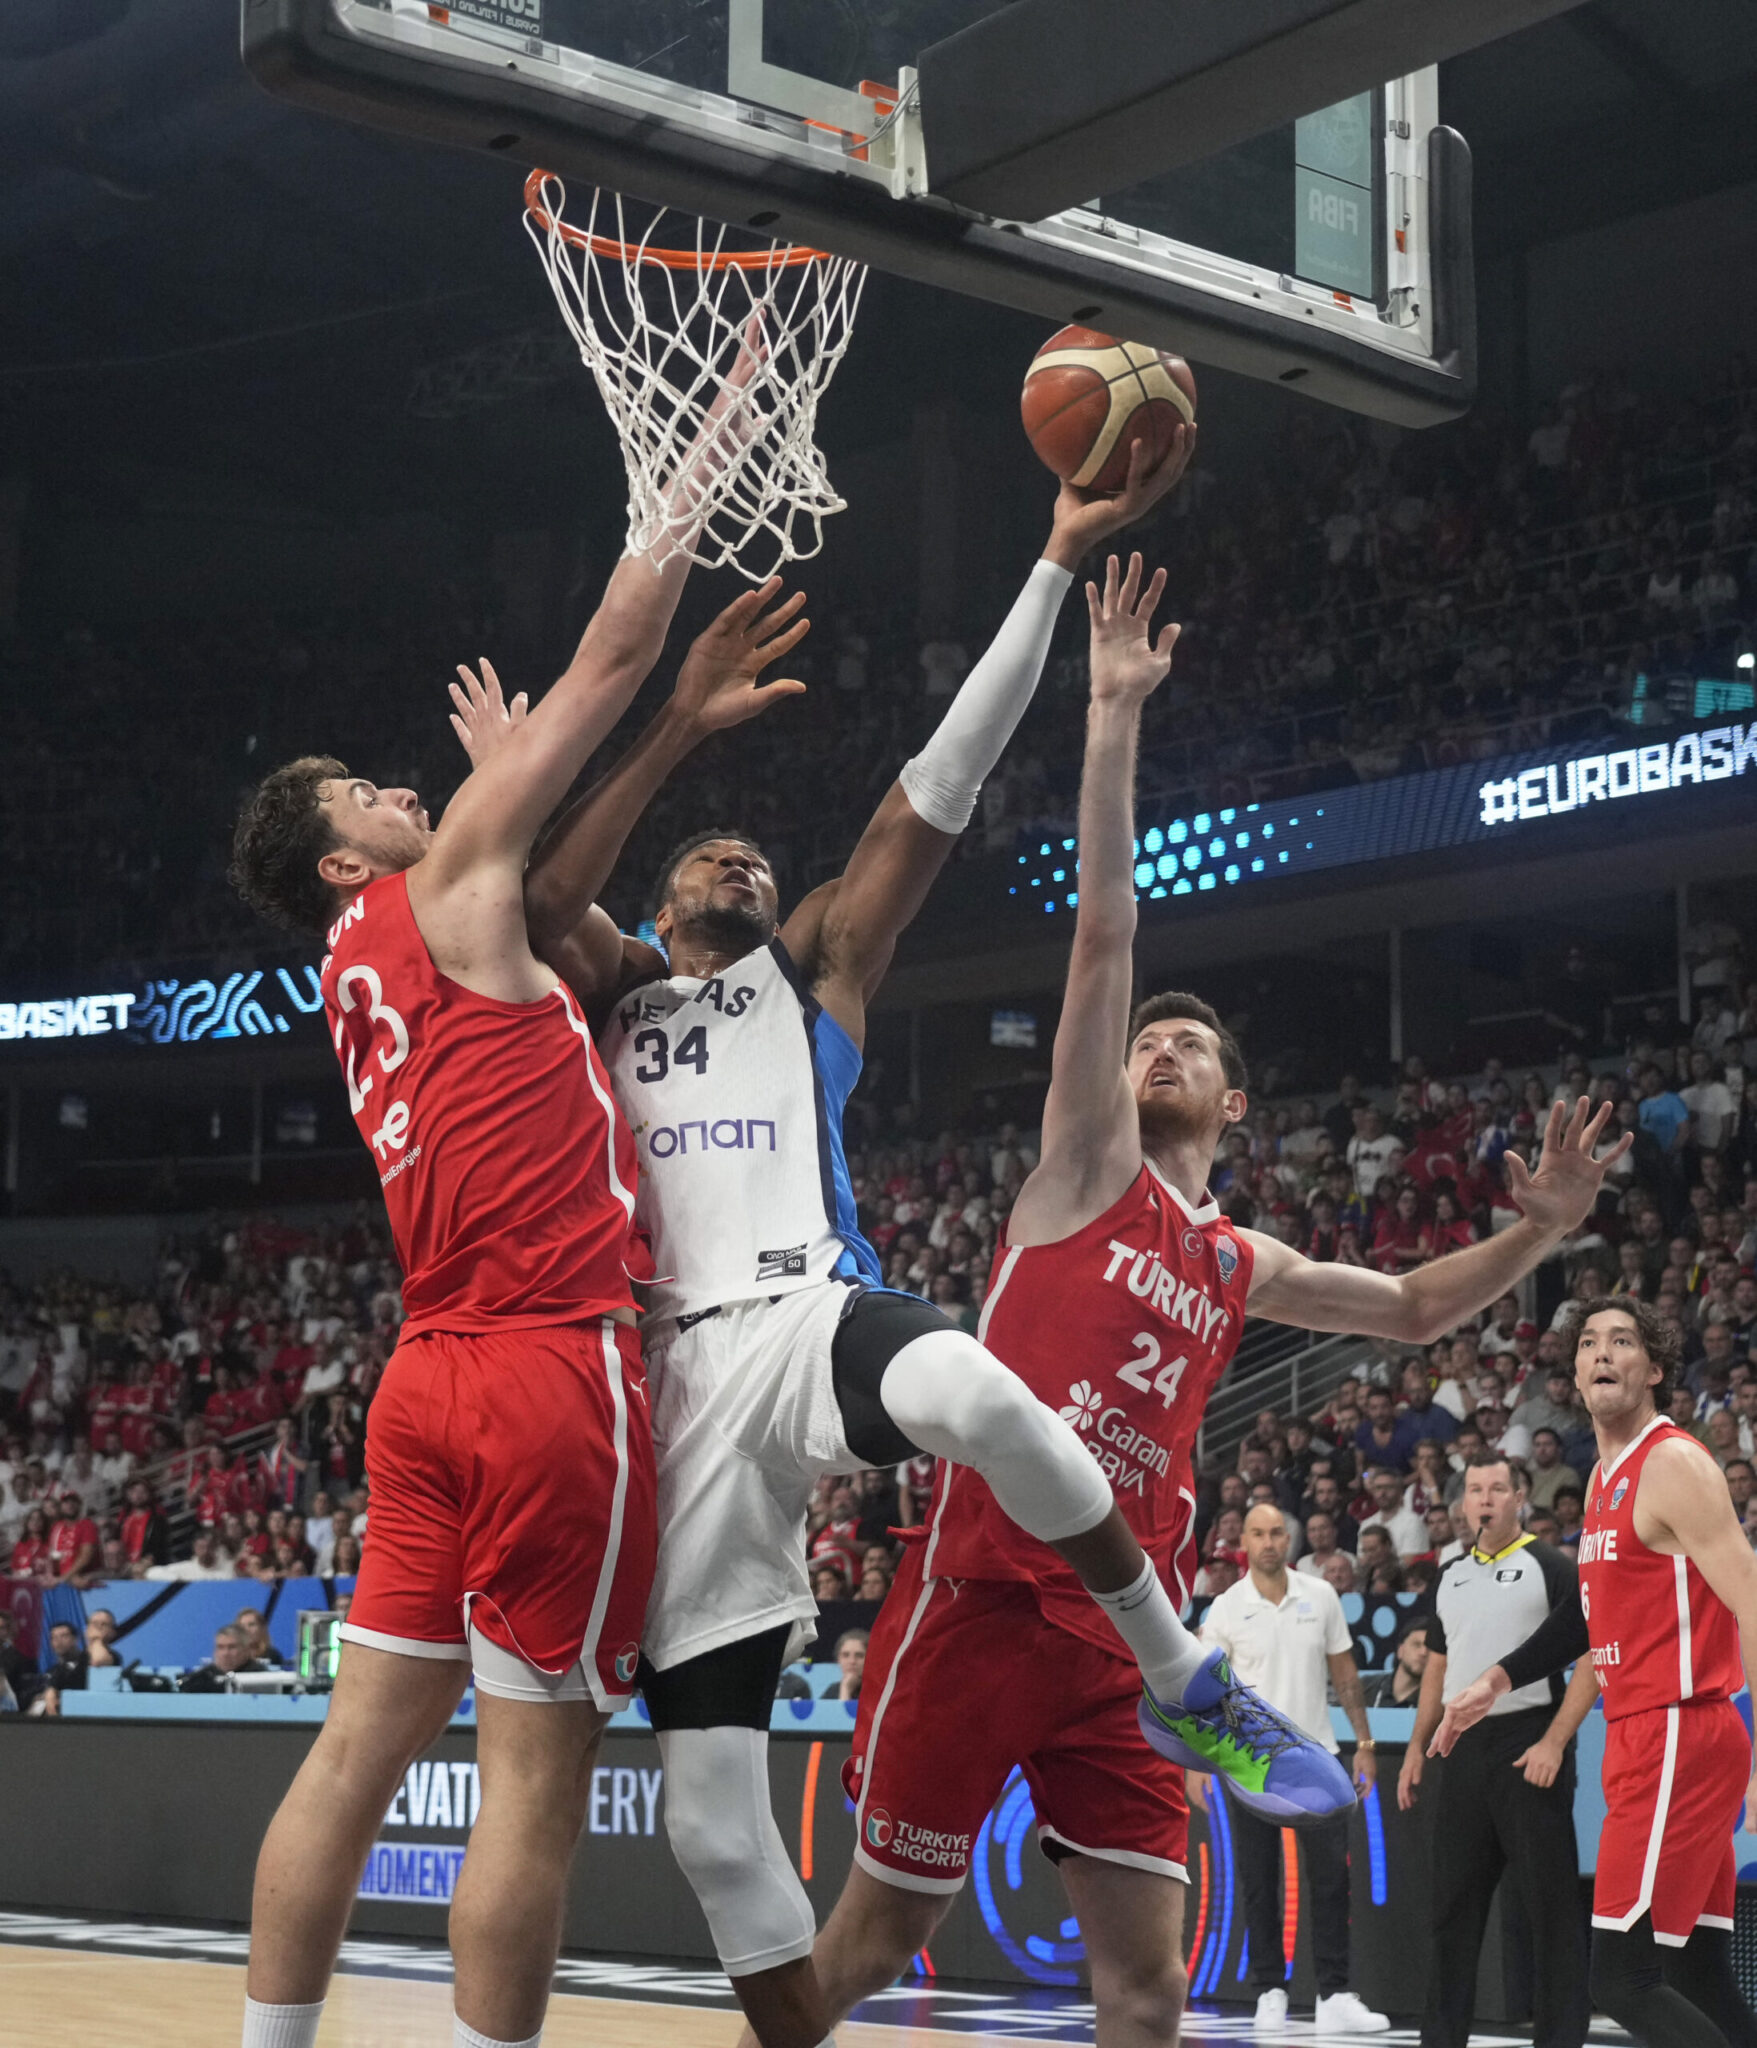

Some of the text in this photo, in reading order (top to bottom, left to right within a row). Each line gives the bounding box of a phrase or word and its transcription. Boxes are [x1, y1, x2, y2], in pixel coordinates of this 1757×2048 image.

[335, 964, 409, 1116] 23
[619, 978, 757, 1034] HEAS
[634, 1025, 710, 1084] 34
[1115, 1332, 1189, 1410] 24
[588, 1766, 663, 1835] ERY
